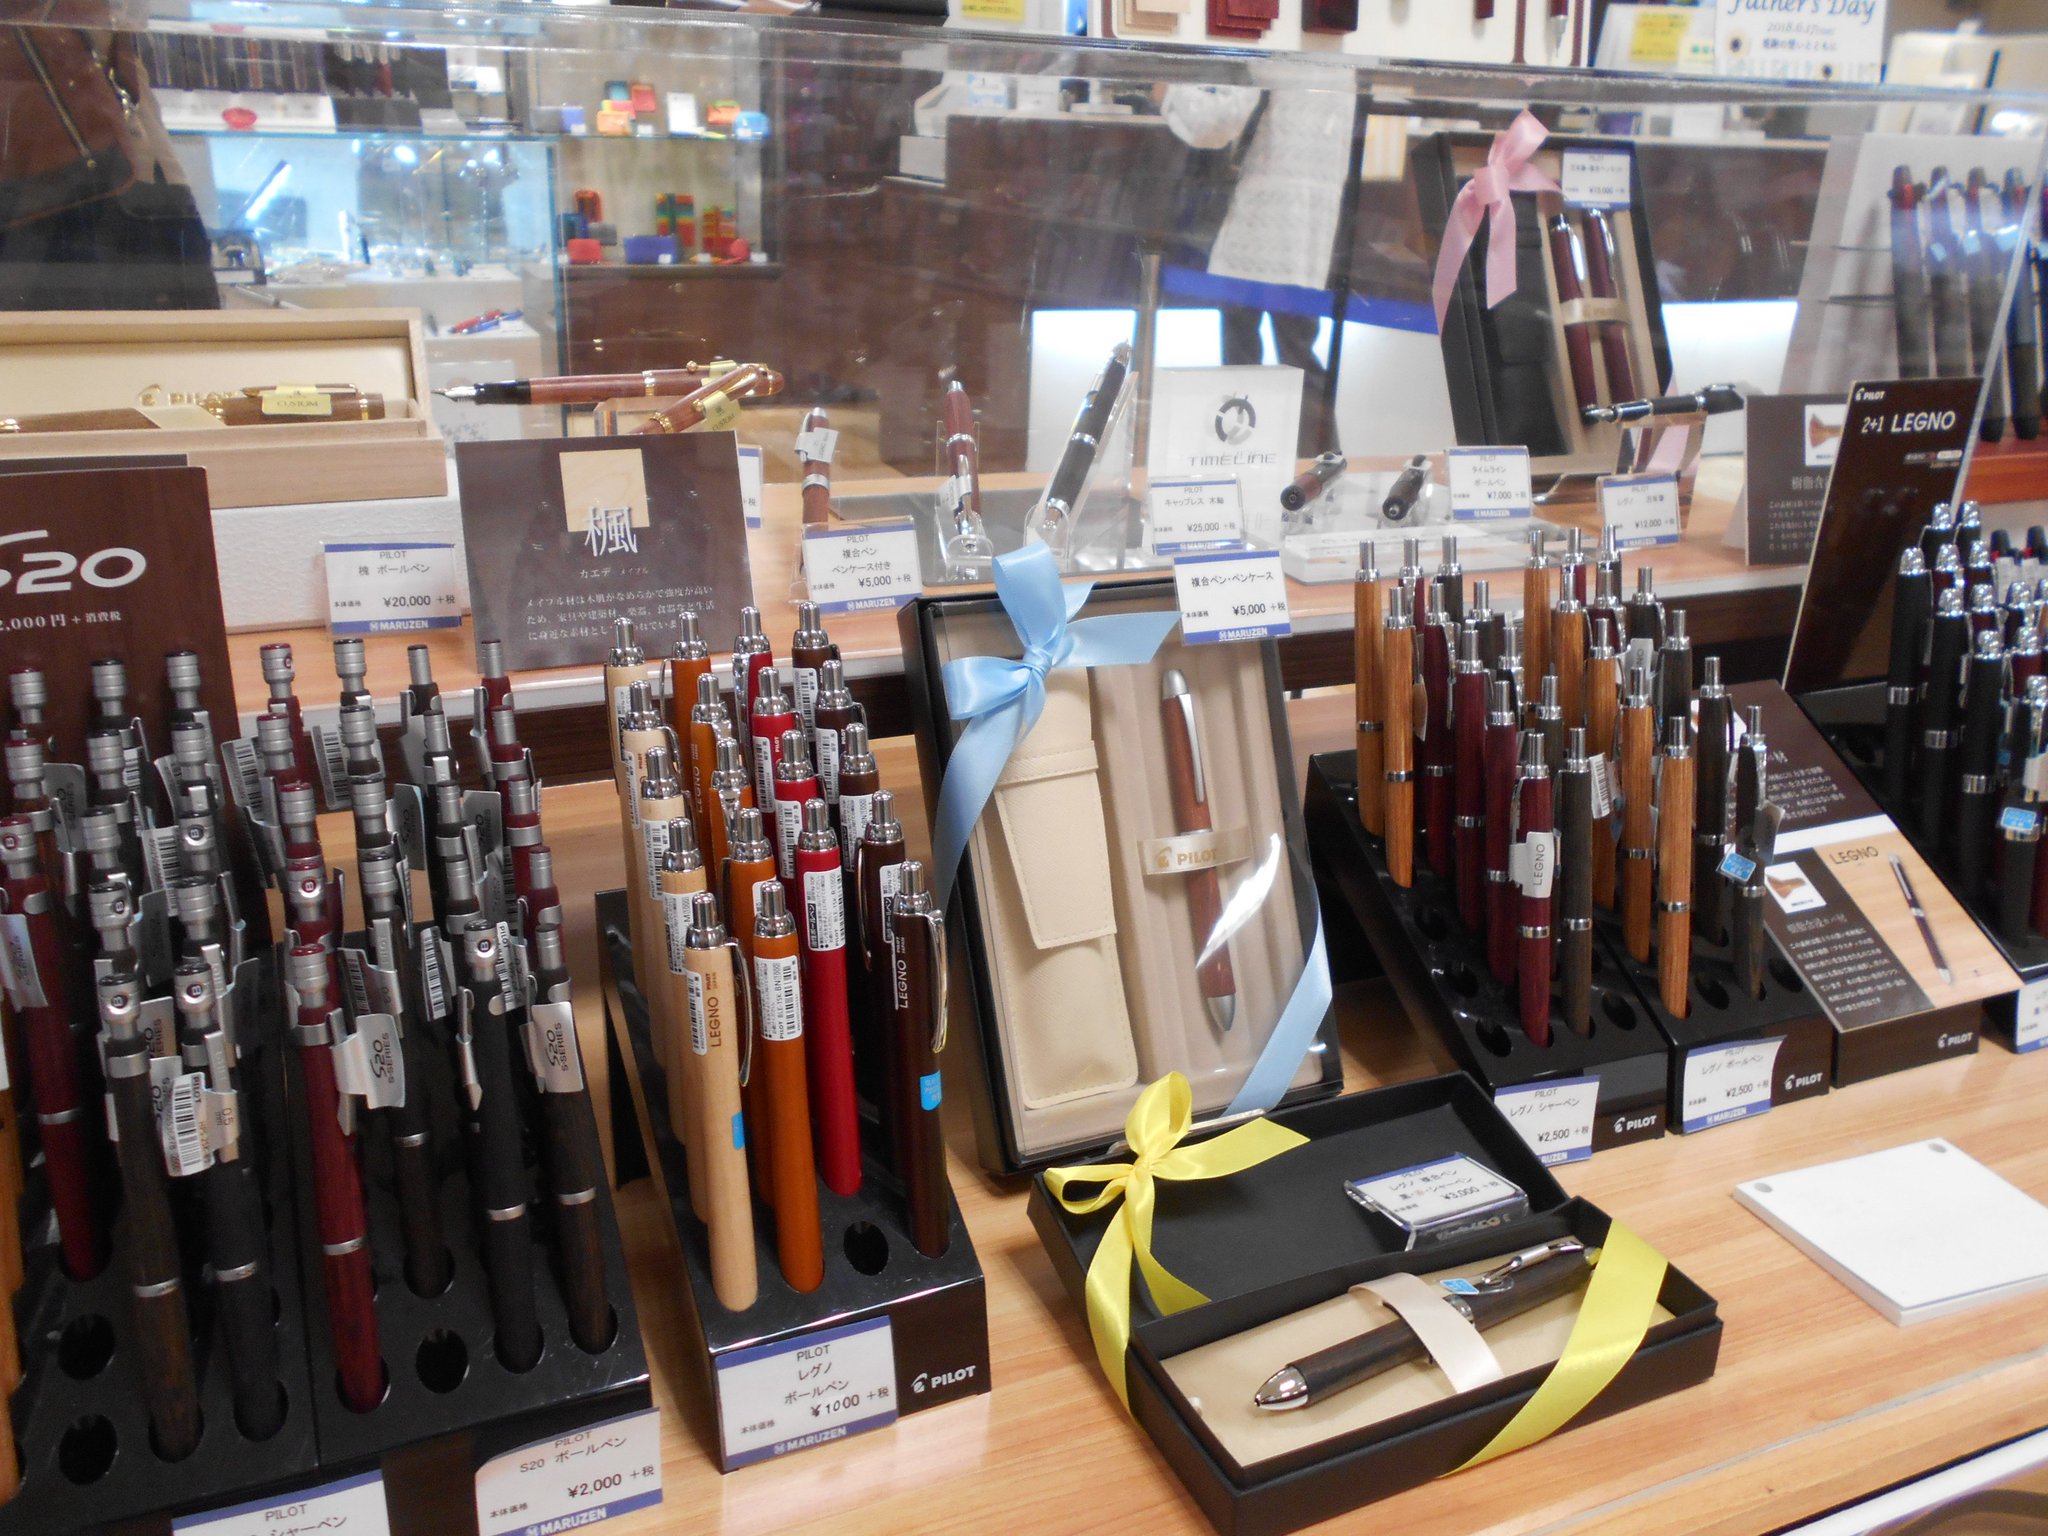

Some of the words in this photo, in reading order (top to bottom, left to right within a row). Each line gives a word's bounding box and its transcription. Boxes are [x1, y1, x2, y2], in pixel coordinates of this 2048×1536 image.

[1827, 0, 1876, 25] Day
[1863, 391, 1886, 400] PILOT
[1861, 416, 1884, 434] 2+1
[1890, 411, 1956, 433] LEGNO
[1188, 452, 1277, 466] TIMELINE
[1472, 466, 1507, 474] タイムライン
[1165, 497, 1205, 507] キャップレス
[1487, 491, 1513, 500] ¥7,000
[584, 506, 639, 557] 楓
[1187, 522, 1220, 532] ¥25,000
[1635, 519, 1662, 528] ¥12,000
[847, 535, 869, 544] PILOT
[379, 551, 407, 560] PILOT
[842, 547, 878, 559] 複合ペン
[377, 564, 430, 575] ボールペン
[579, 567, 611, 579] カエデ
[832, 561, 891, 574] ペンケース付き
[858, 575, 892, 588] ¥5,000
[1191, 571, 1275, 588] 複合ペン・ペンケース
[383, 595, 431, 608] ¥20,000
[856, 597, 896, 609] MARUZEN
[1232, 603, 1267, 617] ¥5,000
[51, 613, 67, 628] 円
[85, 610, 123, 624] 消費税
[380, 620, 429, 631] MARUZEN
[1227, 627, 1269, 639] MARUZEN
[1177, 848, 1218, 865] PILOT
[1829, 846, 1879, 865] LEGNO
[1532, 843, 1545, 886] LEGNO
[499, 925, 509, 950] PILOT
[897, 959, 909, 1009] LEGNO
[708, 996, 722, 1048] LEGNO
[1947, 1032, 1974, 1046] PILOT
[547, 1029, 561, 1067] S20
[370, 1039, 386, 1079] S20
[1702, 1063, 1721, 1075] レグノ
[1726, 1055, 1764, 1069] ボールペン
[1795, 1073, 1823, 1088] PILOT
[193, 1076, 202, 1103] PILOT
[1534, 1088, 1558, 1098] PILOT
[1726, 1083, 1753, 1098] ¥2,500
[1510, 1105, 1535, 1117] レグノ
[1539, 1098, 1580, 1112] シャーペン
[1714, 1107, 1747, 1123] MARUZEN
[1626, 1115, 1657, 1130] PILOT
[1538, 1128, 1569, 1142] ¥2,500
[1541, 1151, 1568, 1163] RUZEN
[1420, 1169, 1457, 1183] 複合ペン
[1441, 1186, 1480, 1201] ¥3,000
[796, 1344, 831, 1362] PILOT
[798, 1362, 833, 1381] レグノ
[931, 1365, 977, 1389] PILOT
[784, 1380, 849, 1405] ボールペン
[740, 1419, 776, 1435] 本体価格
[554, 1432, 592, 1448] PILOT
[786, 1426, 848, 1452] MARUZEN
[520, 1459, 546, 1473] S20
[554, 1438, 628, 1463] ボールペン
[489, 1503, 529, 1519] 本体価格
[566, 1473, 623, 1499] ¥2,000
[265, 1504, 308, 1521] PILOT
[271, 1517, 348, 1536] シャーペン
[540, 1507, 608, 1536] MARUZEN
